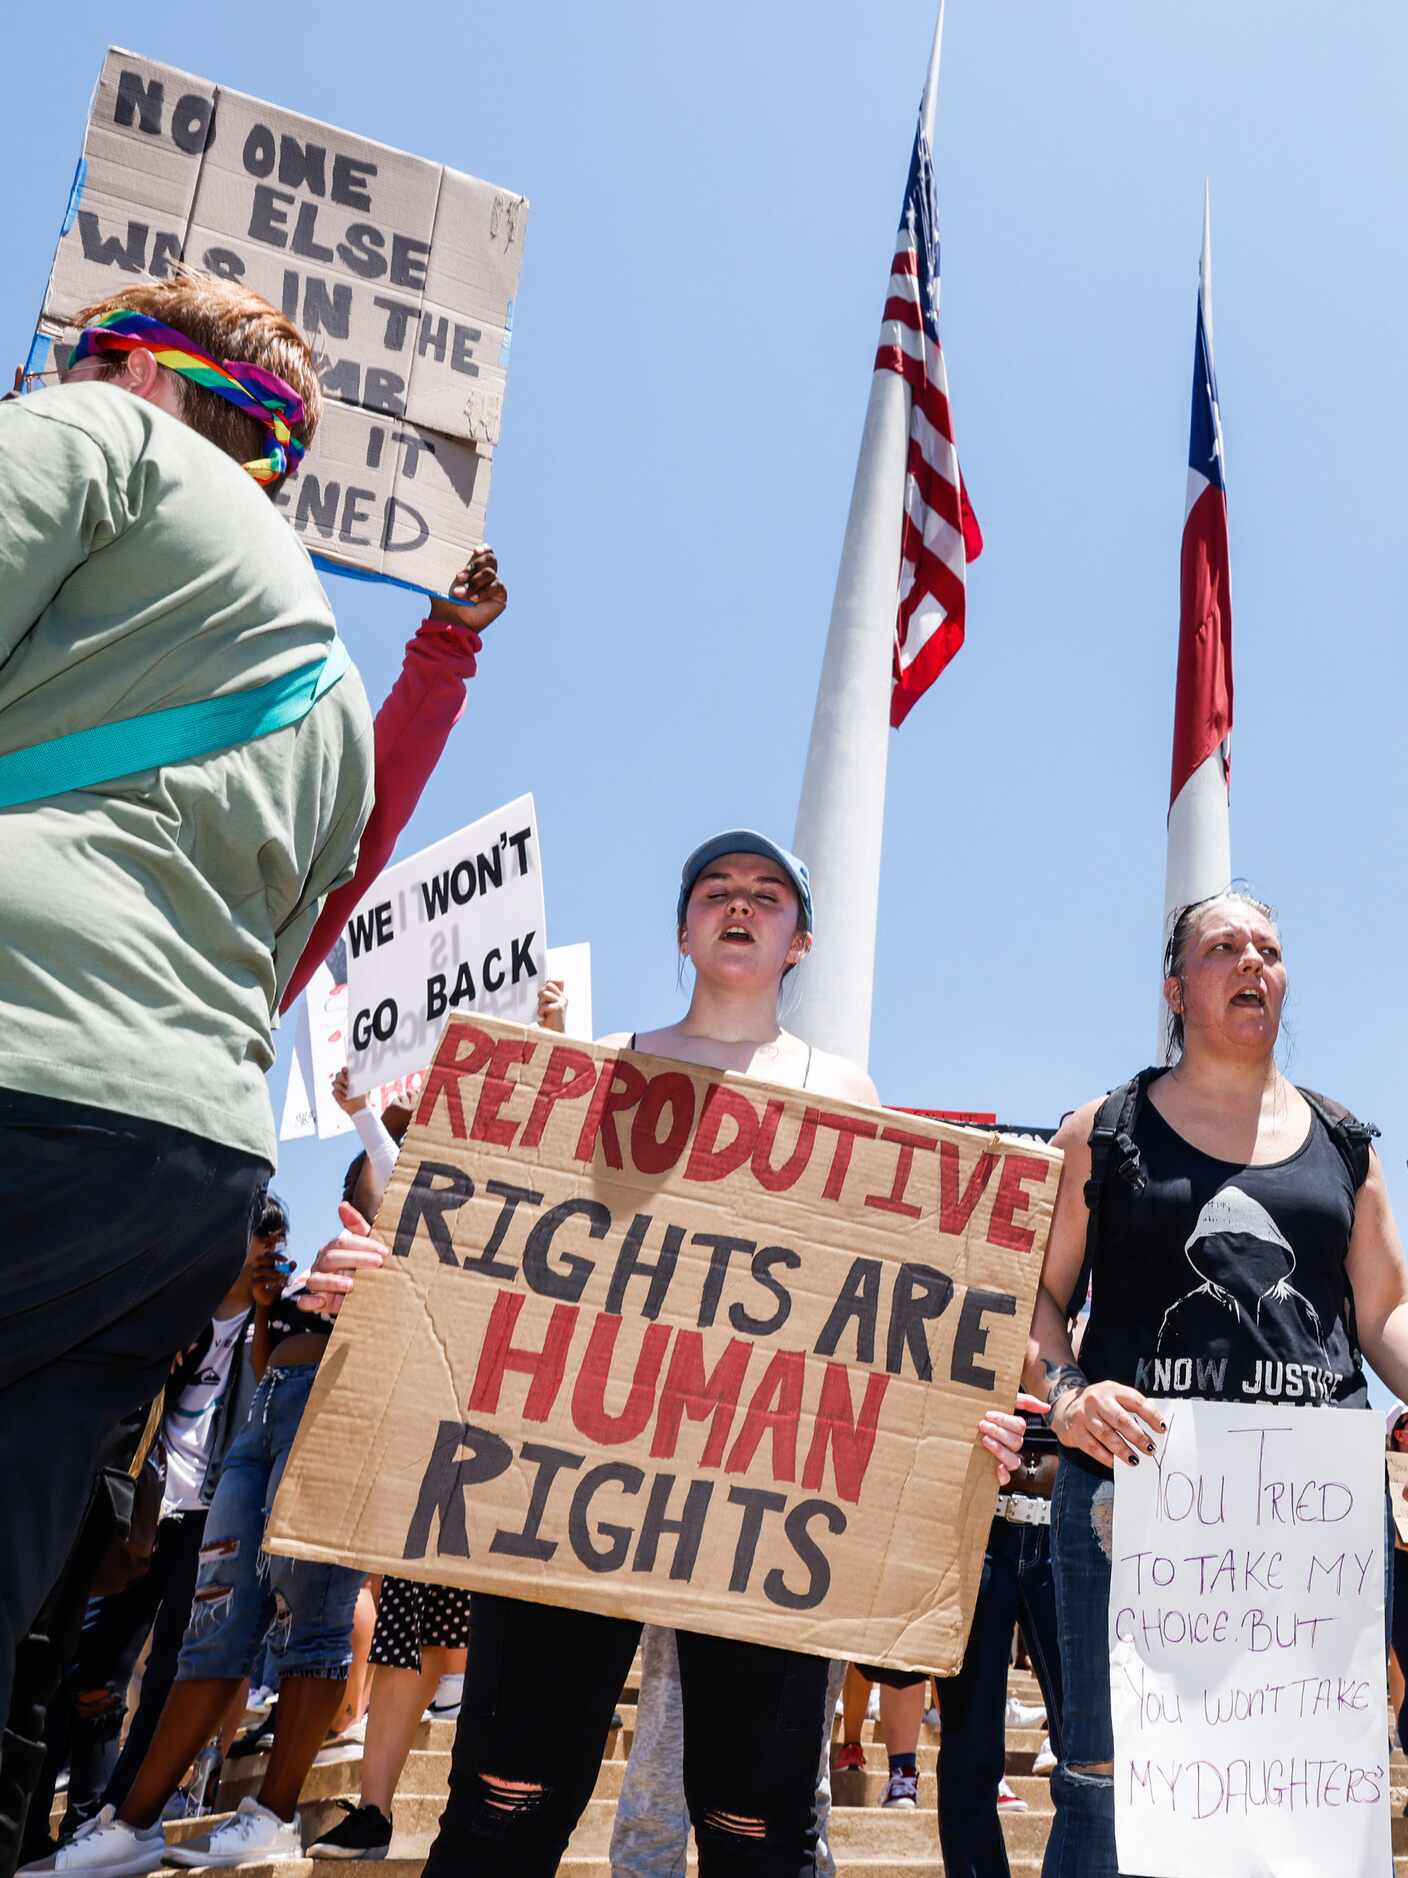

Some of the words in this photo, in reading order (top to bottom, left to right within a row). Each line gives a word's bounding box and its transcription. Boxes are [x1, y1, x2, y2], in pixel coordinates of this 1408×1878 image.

[114, 70, 217, 155] NO
[242, 124, 377, 212] ONE
[248, 184, 431, 290] ELSE
[281, 271, 351, 340] IN
[374, 294, 482, 377] THE
[366, 426, 435, 479] IT
[348, 900, 394, 959] WE
[421, 827, 532, 921] WON'T
[353, 998, 398, 1051] GO
[426, 931, 538, 1021] BACK
[415, 1023, 1049, 1254] REPRODUTIVE
[392, 1161, 801, 1336] RIGHTS
[813, 1257, 1017, 1392] ARE
[467, 1289, 891, 1504] HUMAN
[1134, 1357, 1229, 1392] KNOW
[1242, 1360, 1344, 1402] JUSTICE
[402, 1420, 847, 1611] RIGHTS
[1134, 1413, 1225, 1525] YOU
[1227, 1427, 1355, 1526] TRIED
[1121, 1551, 1175, 1595] TO
[1183, 1549, 1284, 1595] TAKE
[1306, 1549, 1374, 1595] MY
[1241, 1609, 1341, 1652] BUT
[1288, 1676, 1370, 1718] TAKE
[1129, 1759, 1183, 1812] MY
